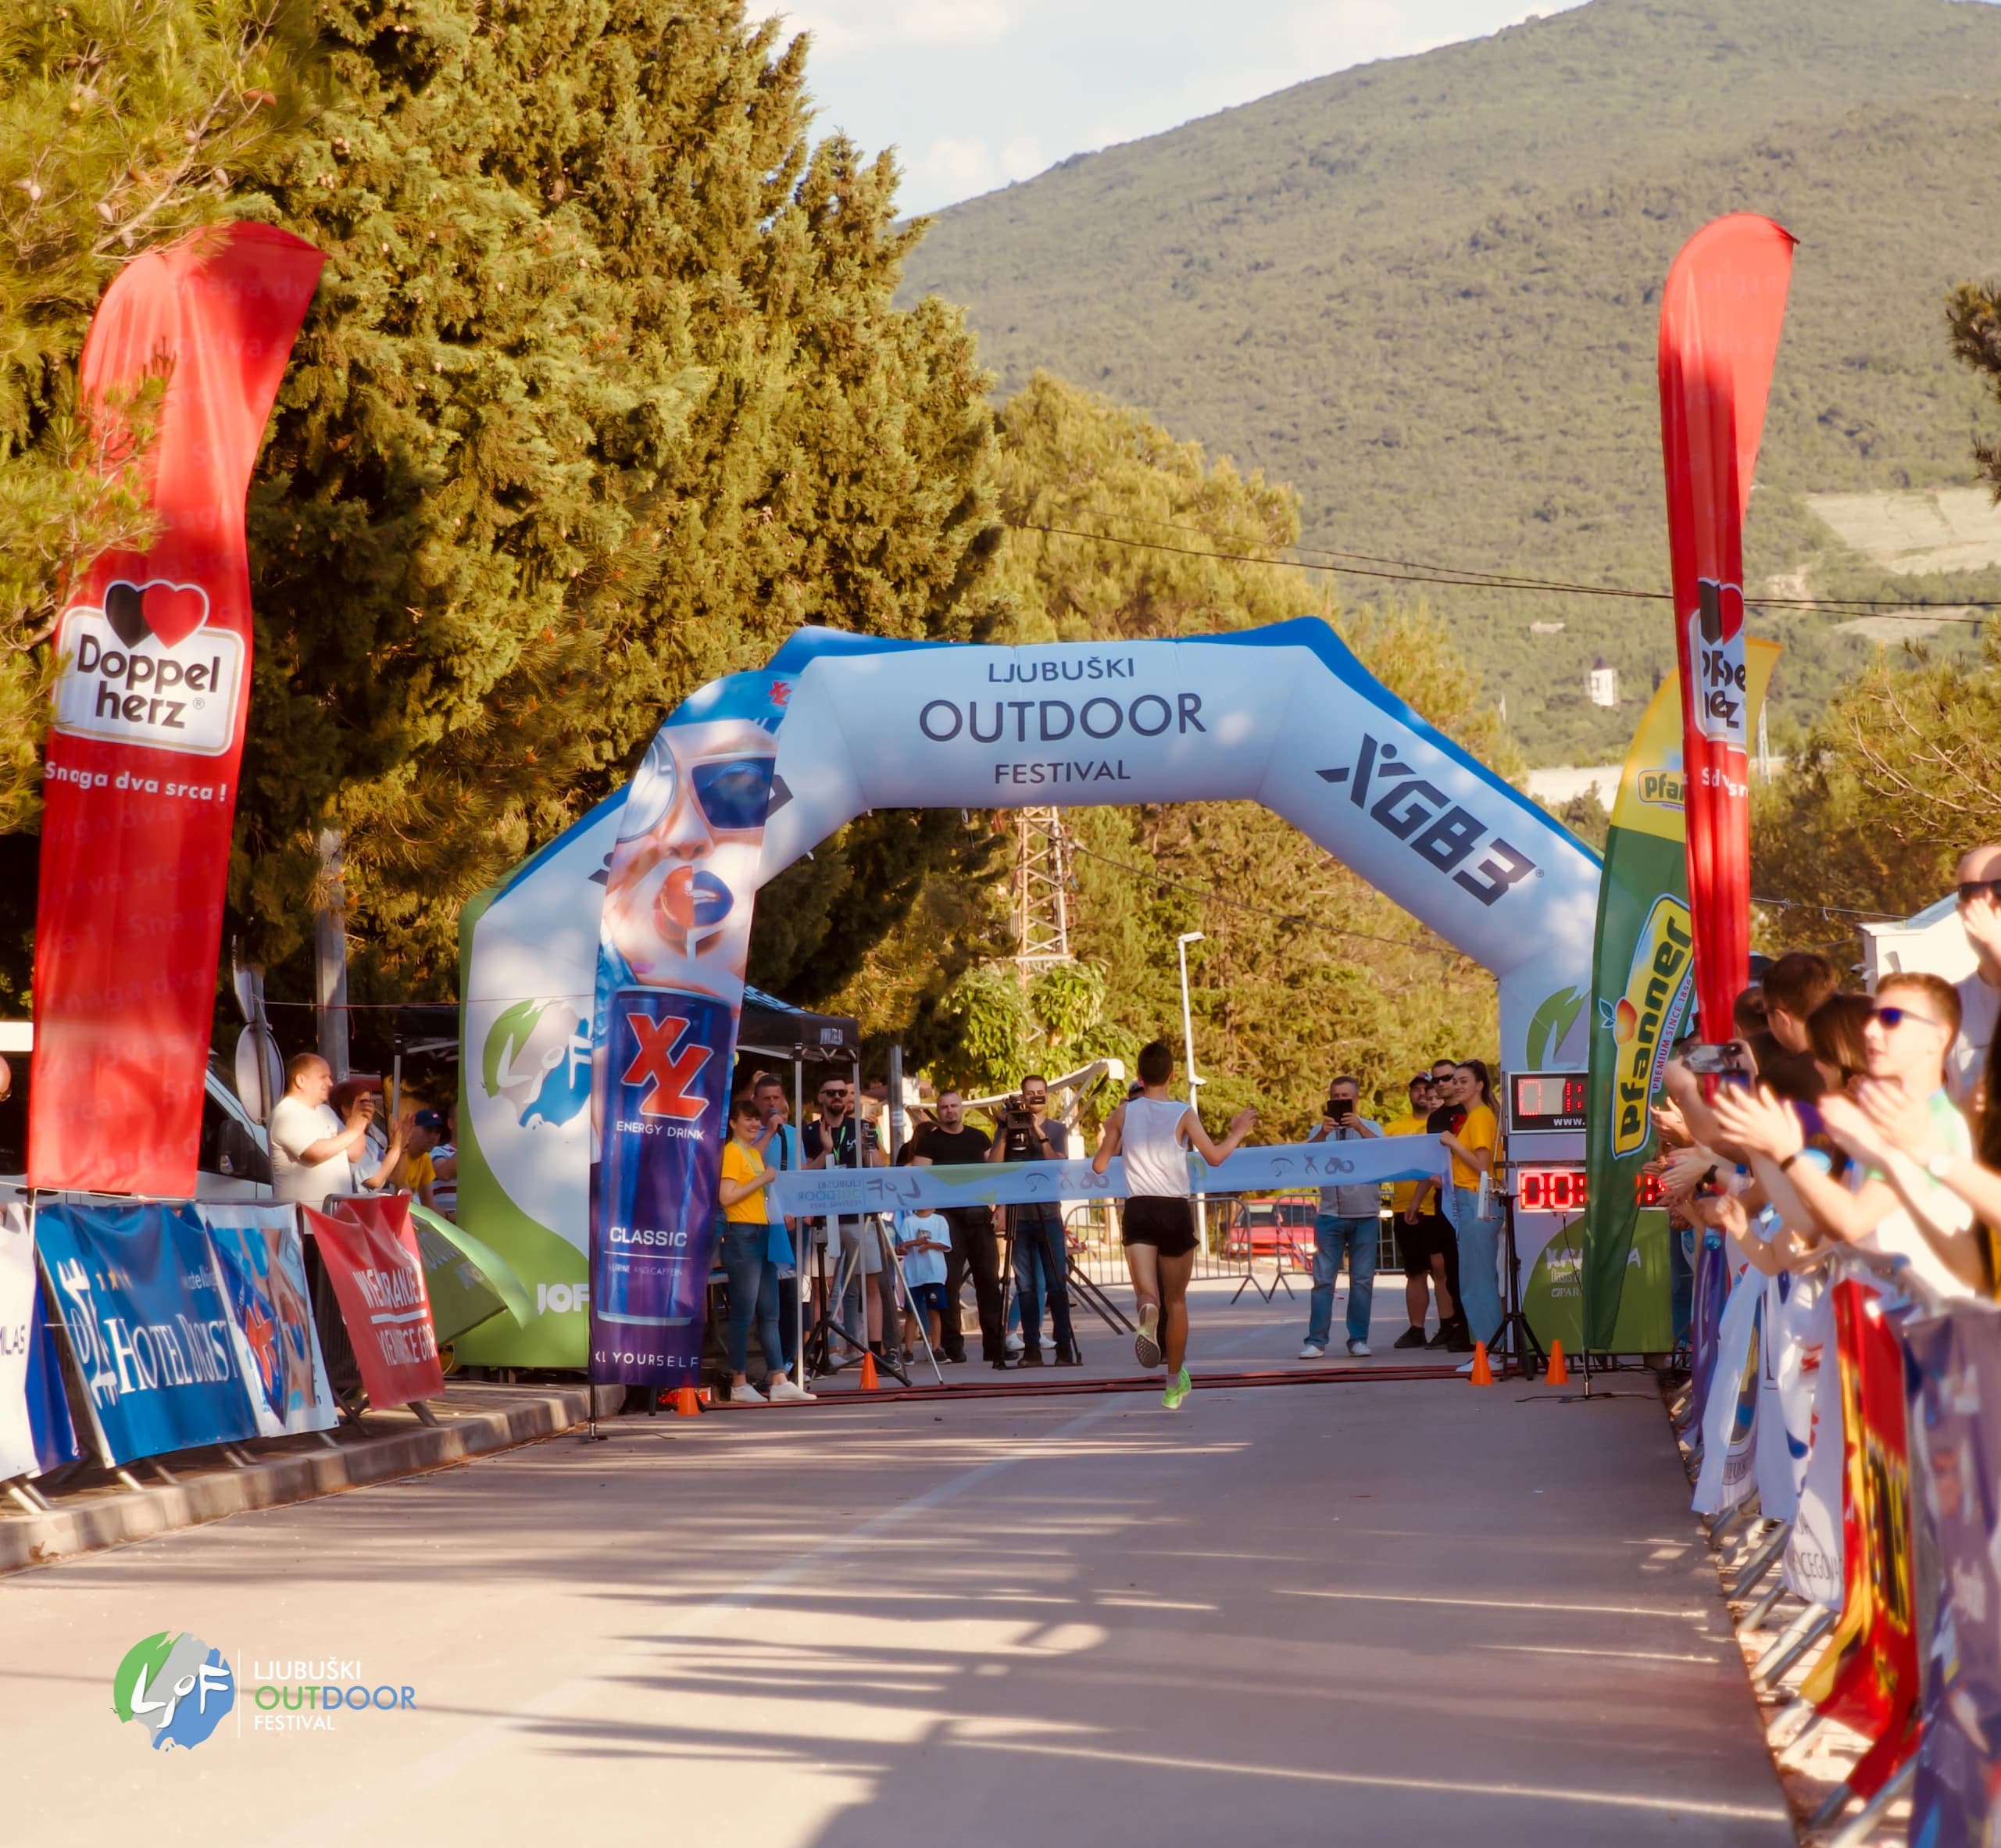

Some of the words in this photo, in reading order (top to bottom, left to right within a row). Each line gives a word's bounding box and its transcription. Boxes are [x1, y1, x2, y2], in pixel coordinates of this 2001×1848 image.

[77, 634, 220, 694] Doppel
[988, 657, 1134, 684] LJUBUŠKI
[95, 681, 188, 728] herz
[920, 693, 1206, 743] OUTDOOR
[45, 761, 108, 789] Snaga
[115, 772, 158, 793] dva
[166, 784, 213, 800] srca
[995, 760, 1131, 785] FESTIVAL
[1653, 1039, 1670, 1089] PREMIUM
[1666, 1006, 1682, 1036] SINCE
[1680, 978, 1692, 1003] 1856
[620, 1013, 714, 1121] XL
[616, 1121, 663, 1135] ENERGY
[666, 1126, 706, 1140] DRINK
[609, 1226, 688, 1248] CLASSIC
[103, 1318, 194, 1395] HOTEL
[613, 1351, 699, 1367] YOURSELF
